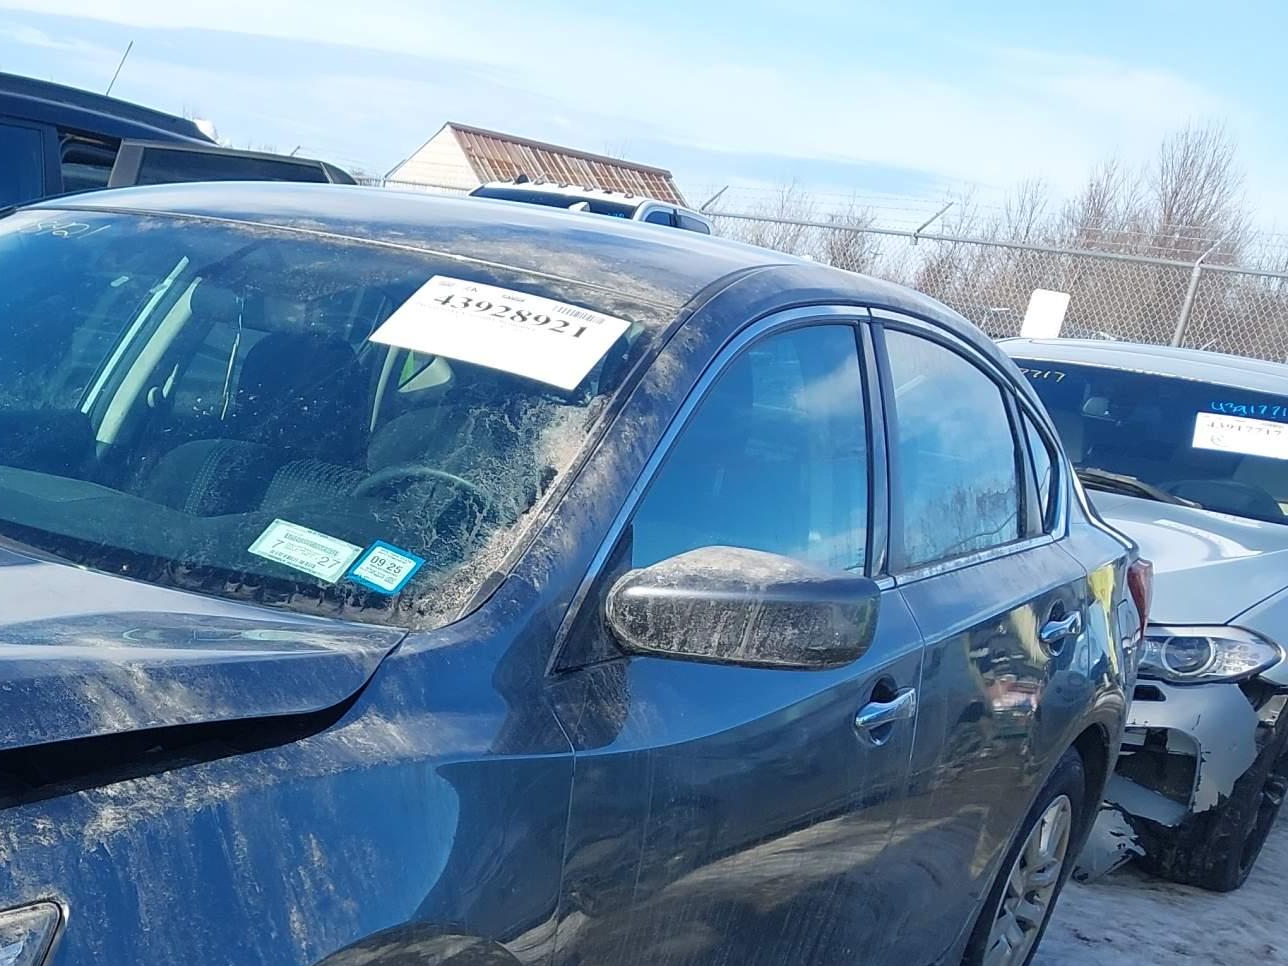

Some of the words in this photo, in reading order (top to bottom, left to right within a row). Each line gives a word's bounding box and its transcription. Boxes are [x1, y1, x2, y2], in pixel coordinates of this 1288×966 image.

[434, 294, 588, 338] 43928921
[370, 555, 386, 567] 09
[386, 562, 403, 574] 25
